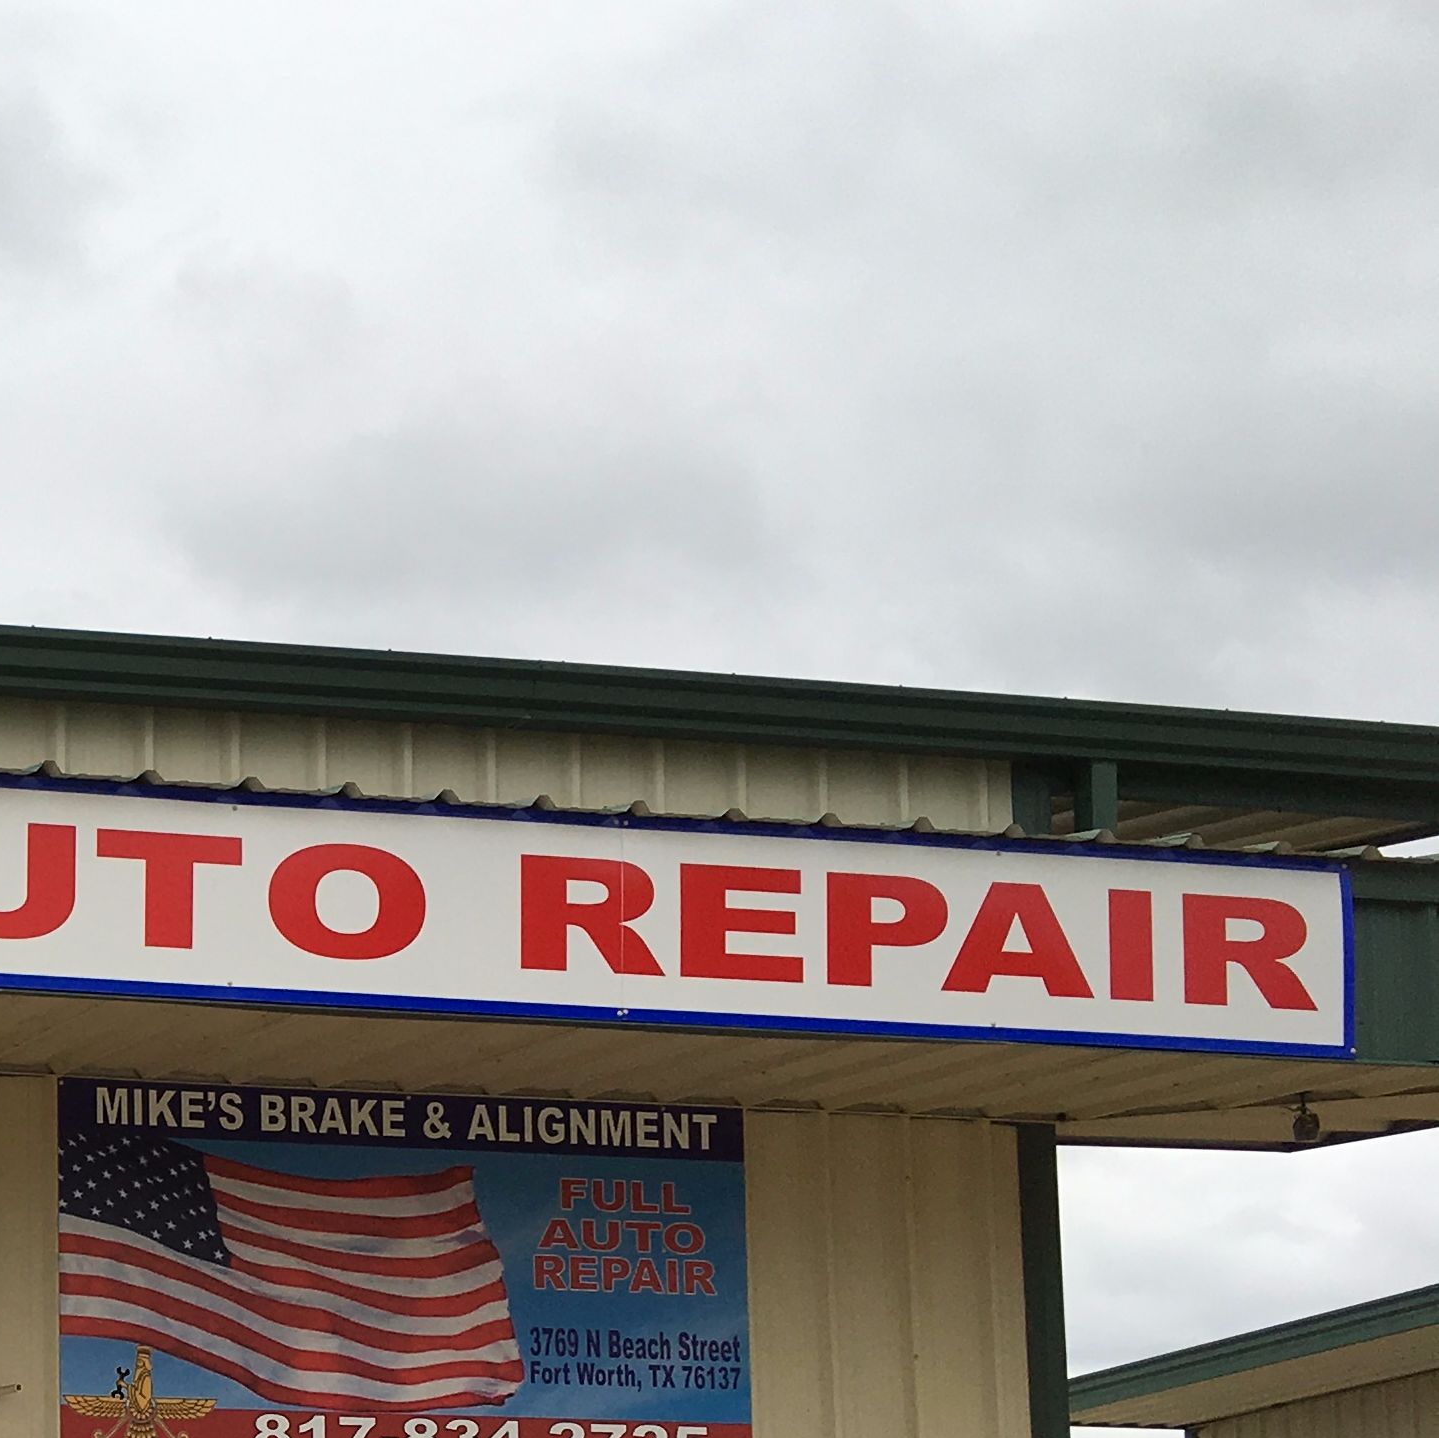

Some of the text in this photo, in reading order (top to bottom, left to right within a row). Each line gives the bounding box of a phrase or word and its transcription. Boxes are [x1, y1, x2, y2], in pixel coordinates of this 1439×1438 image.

[519, 853, 1319, 1011] REPAIR
[95, 1086, 718, 1151] MIKE'S BRAKE & ALIGNMENT
[559, 1177, 692, 1215] FULL
[536, 1217, 707, 1256] AUTO
[532, 1253, 719, 1296] REPAIR
[529, 1326, 742, 1363] 3769 N Beach Street
[529, 1360, 742, 1393] Fort Worth, TX 76137
